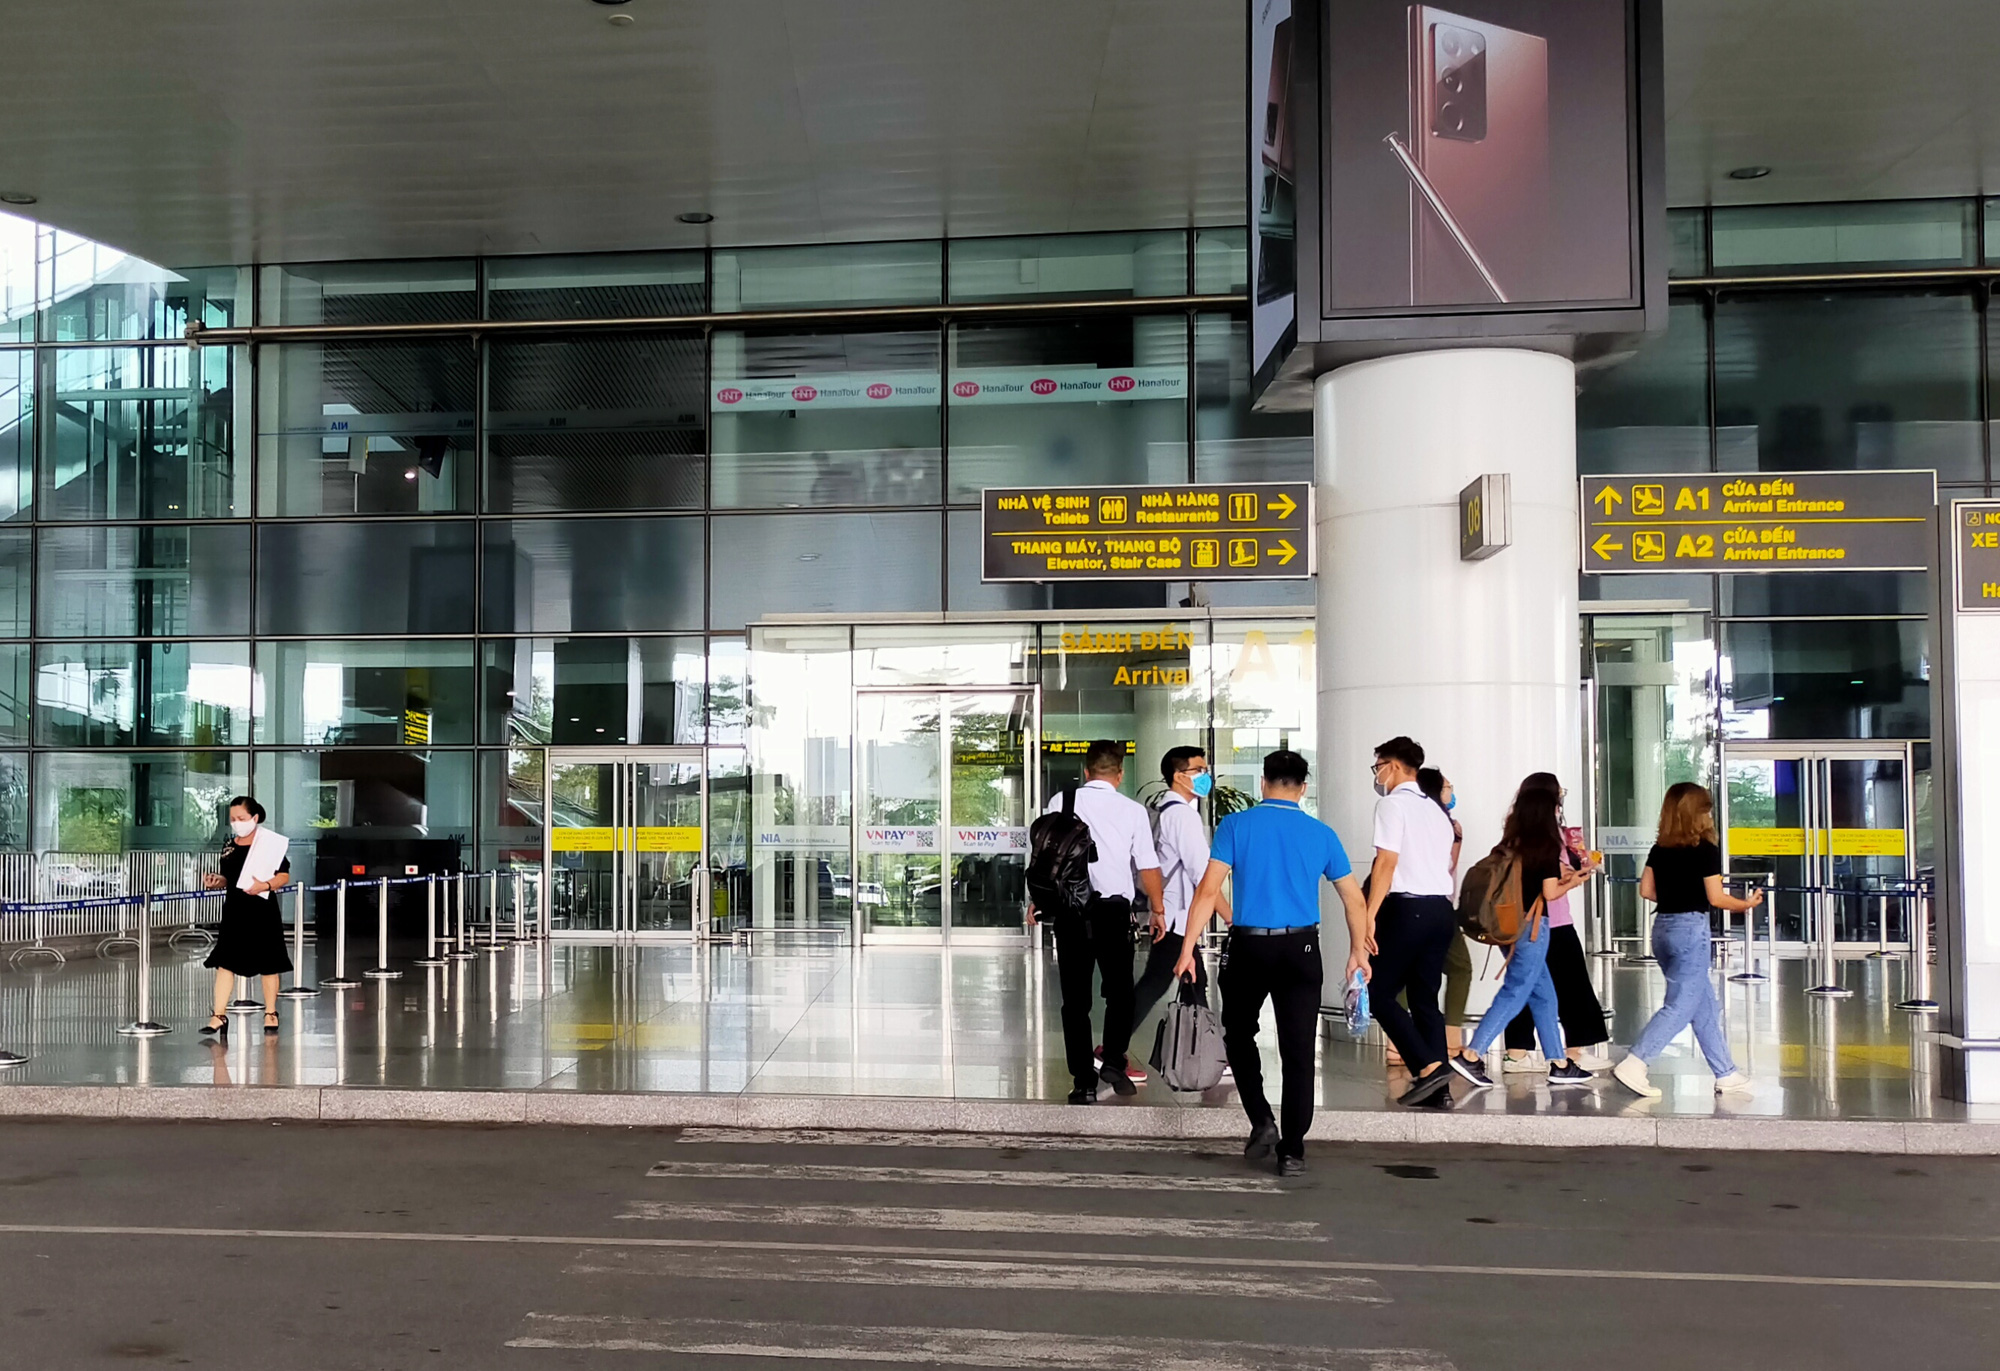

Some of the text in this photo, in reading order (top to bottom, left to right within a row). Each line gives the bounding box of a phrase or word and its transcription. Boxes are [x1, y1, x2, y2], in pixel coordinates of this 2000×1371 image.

[956, 384, 1024, 394] HNT HanaTour
[1033, 381, 1102, 392] HNT HanaTour
[1111, 378, 1181, 389] HNT HanaTour
[720, 391, 740, 400] HNT
[794, 388, 861, 399] HNT HanaTour
[869, 386, 937, 396] HNT HanaTour
[1722, 478, 1794, 496] CỬA ĐẾN
[998, 494, 1090, 511] NHÀ VỆ SINH
[1141, 491, 1220, 507] NHÀ HÀNG
[1674, 486, 1710, 511] A1
[1722, 500, 1845, 513] Arrival Entrance
[1043, 512, 1090, 525] Toilets
[1136, 510, 1220, 523] Restaurants
[1468, 495, 1480, 536] 08
[1722, 525, 1795, 544] CỬA ĐẾN
[1971, 532, 1998, 548] XE
[1011, 537, 1181, 555] THANG MÁY, THANG BỘ
[1675, 534, 1714, 558] A2
[1724, 547, 1845, 560] Arrival Entrance
[1046, 556, 1181, 570] Elevator, Stair Case
[1060, 624, 1132, 651] SẢNH
[1231, 628, 1315, 683] A1
[761, 834, 780, 843] NIA
[866, 830, 906, 840] VNPAY
[958, 831, 999, 840] VNPAY
[1606, 835, 1628, 846] NIA
